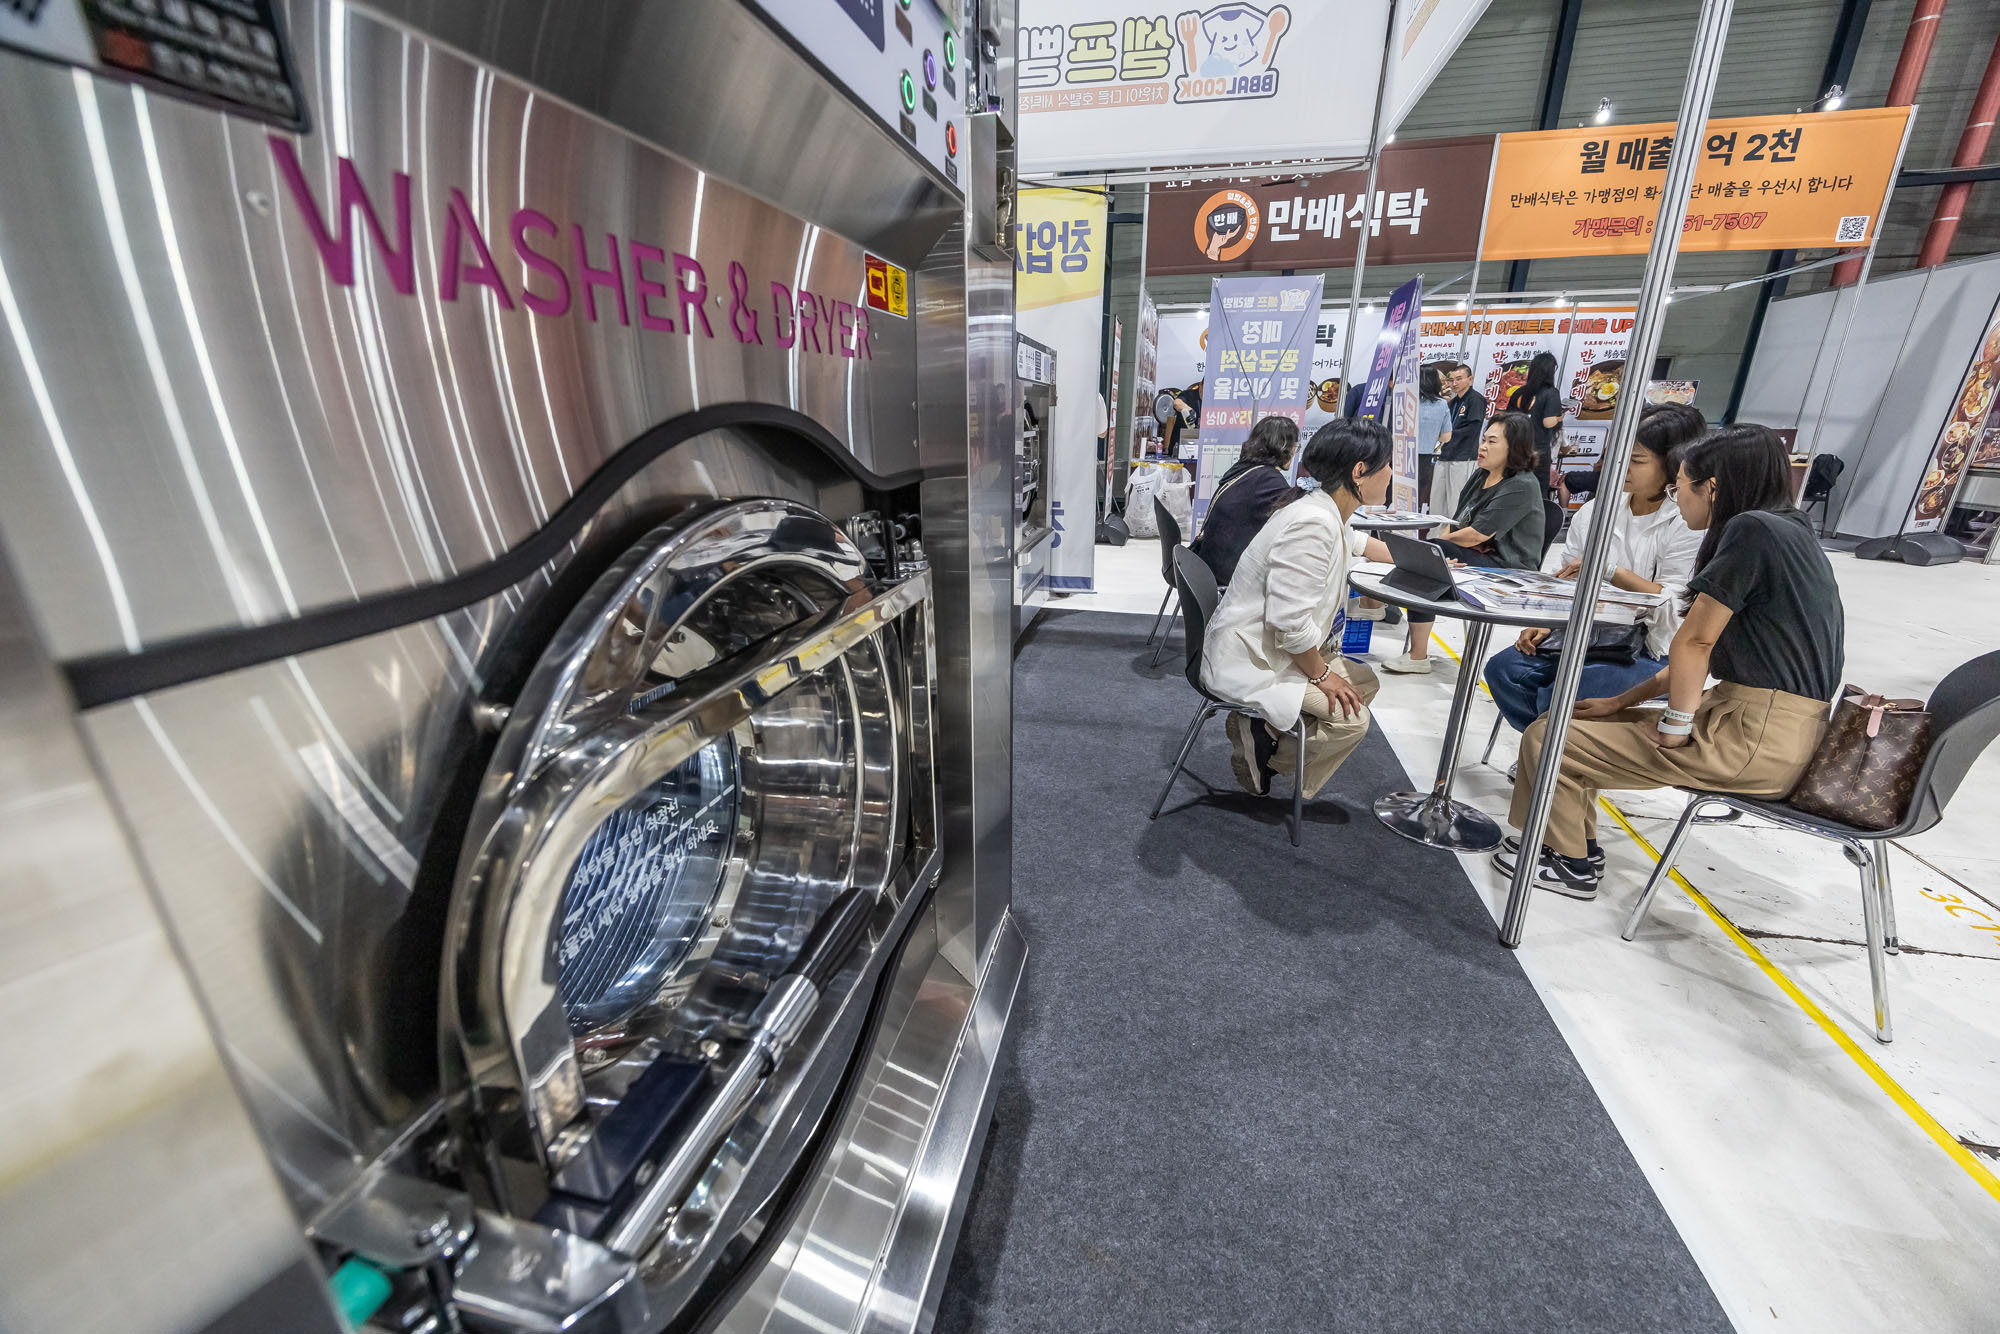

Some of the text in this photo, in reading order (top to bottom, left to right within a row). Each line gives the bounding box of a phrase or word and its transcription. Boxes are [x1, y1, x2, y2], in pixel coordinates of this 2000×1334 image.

[1580, 128, 1803, 174] 월 매출 억 2천
[1510, 190, 1579, 209] 만배식탁은
[1584, 184, 1639, 206] 가맹점의
[1708, 179, 1752, 199] 매출을
[1757, 177, 1802, 196] 우선시
[1808, 175, 1853, 193] 합니다
[1214, 212, 1238, 227] 만배
[1268, 187, 1429, 243] 만배식탁
[1572, 216, 1642, 239] 가맹문의
[1683, 210, 1768, 232] 51-7507
[268, 134, 713, 339] WASHER
[728, 260, 763, 345] &
[771, 280, 872, 360] DRYER
[1495, 319, 1554, 335] 이벤트로
[1611, 318, 1634, 334] UP
[619, 826, 644, 855] 투입
[598, 896, 625, 927] 세탁
